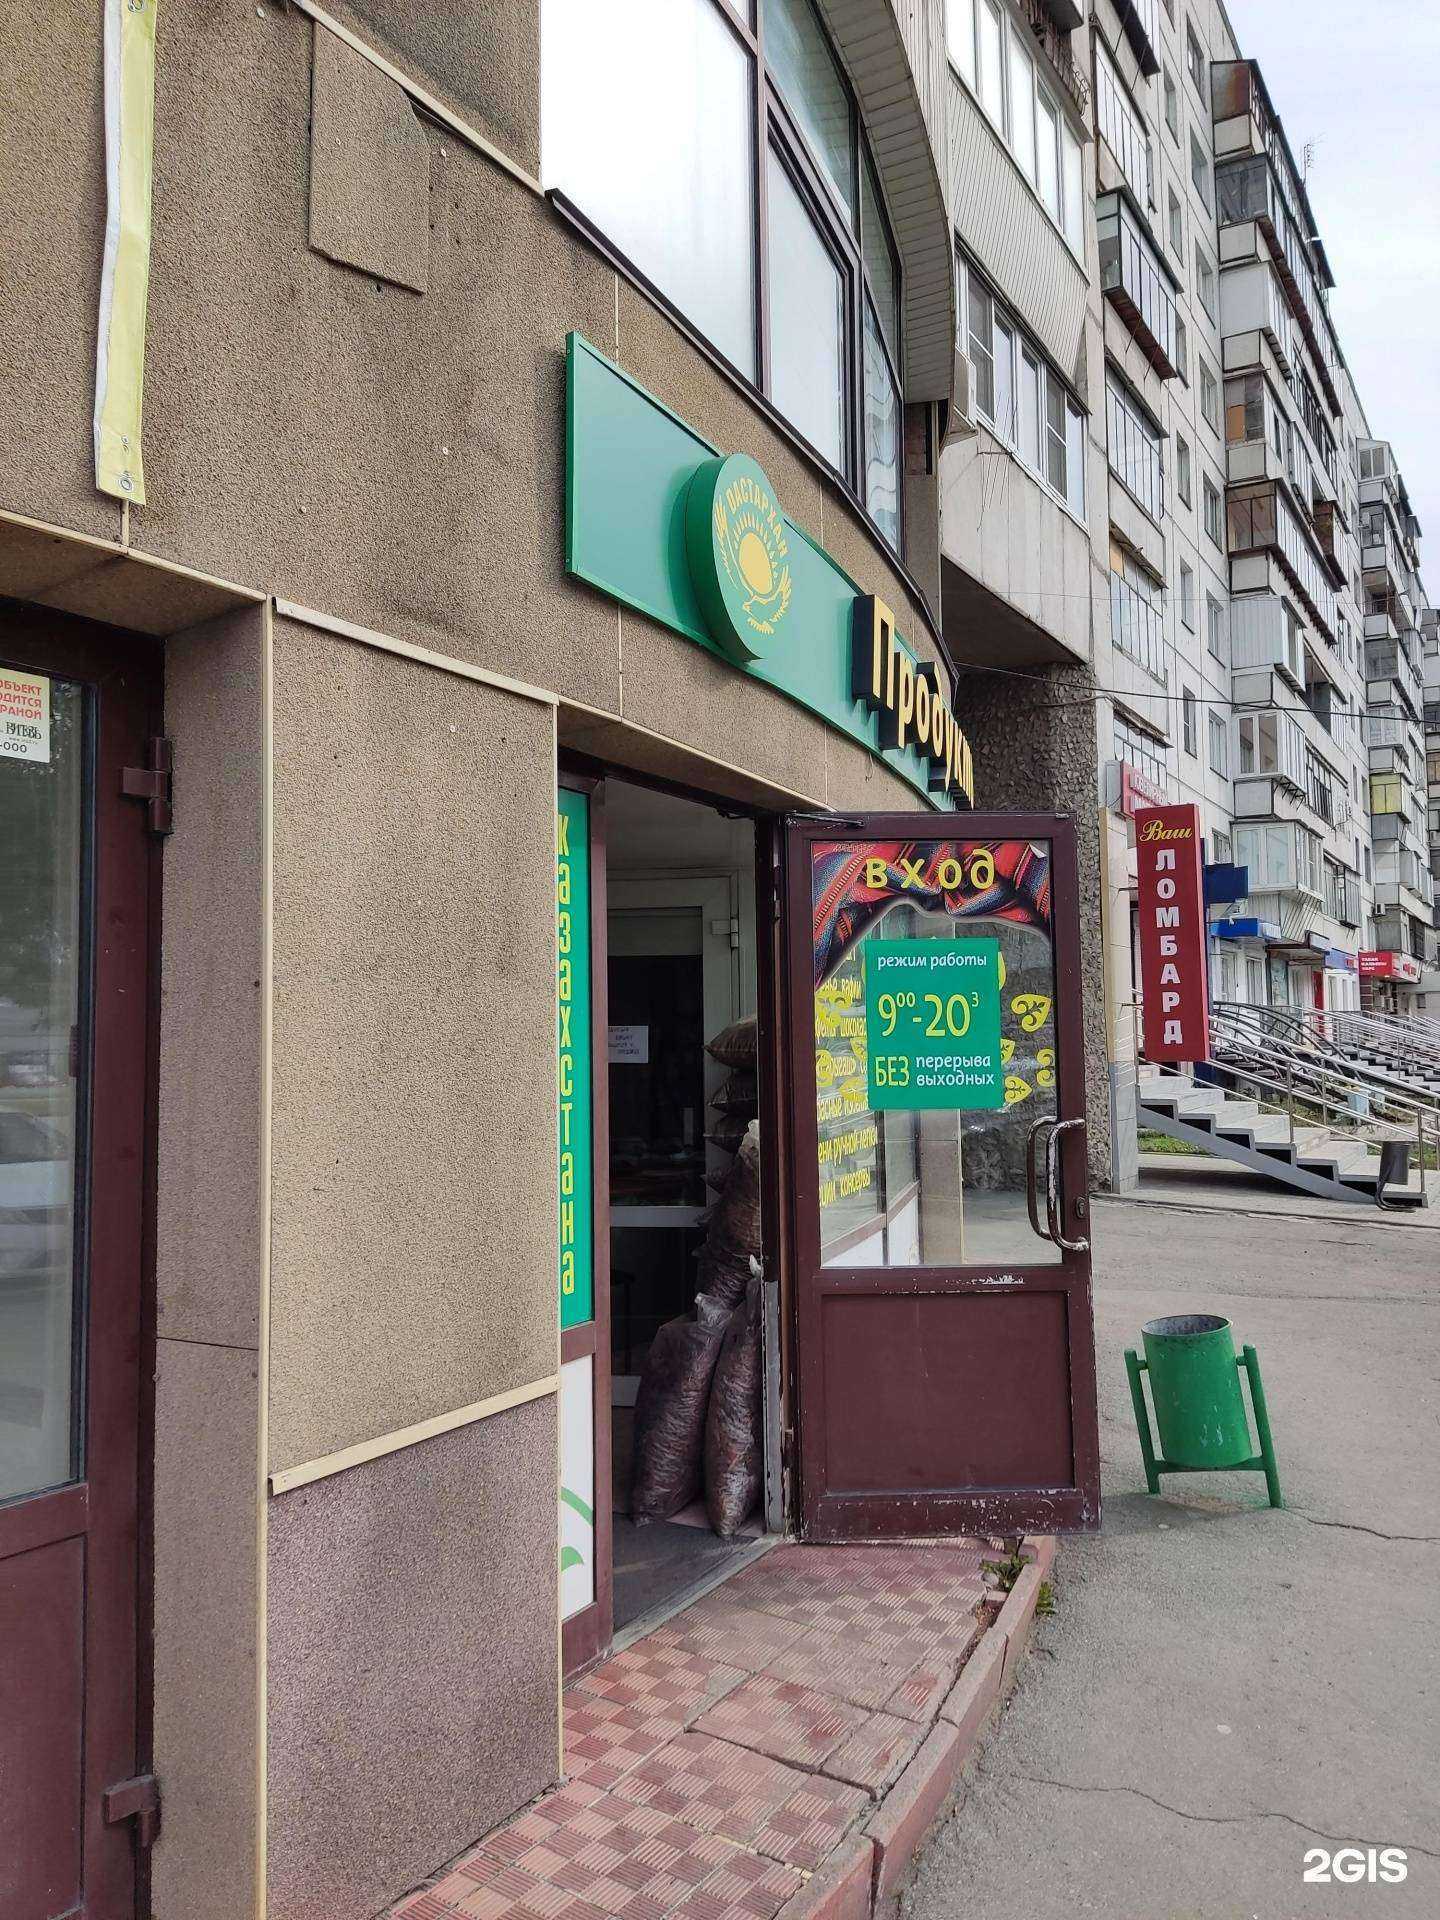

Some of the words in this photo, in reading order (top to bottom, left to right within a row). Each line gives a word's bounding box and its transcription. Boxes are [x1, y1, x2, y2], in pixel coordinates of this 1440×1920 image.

[1139, 819, 1193, 842] Ваш
[1155, 848, 1184, 1045] ЛОМБАРД
[877, 955, 927, 971] режим
[930, 952, 987, 971] работы
[875, 1056, 910, 1087] БЕЗ
[915, 1055, 991, 1072] перерыва
[915, 1069, 995, 1087] выходных
